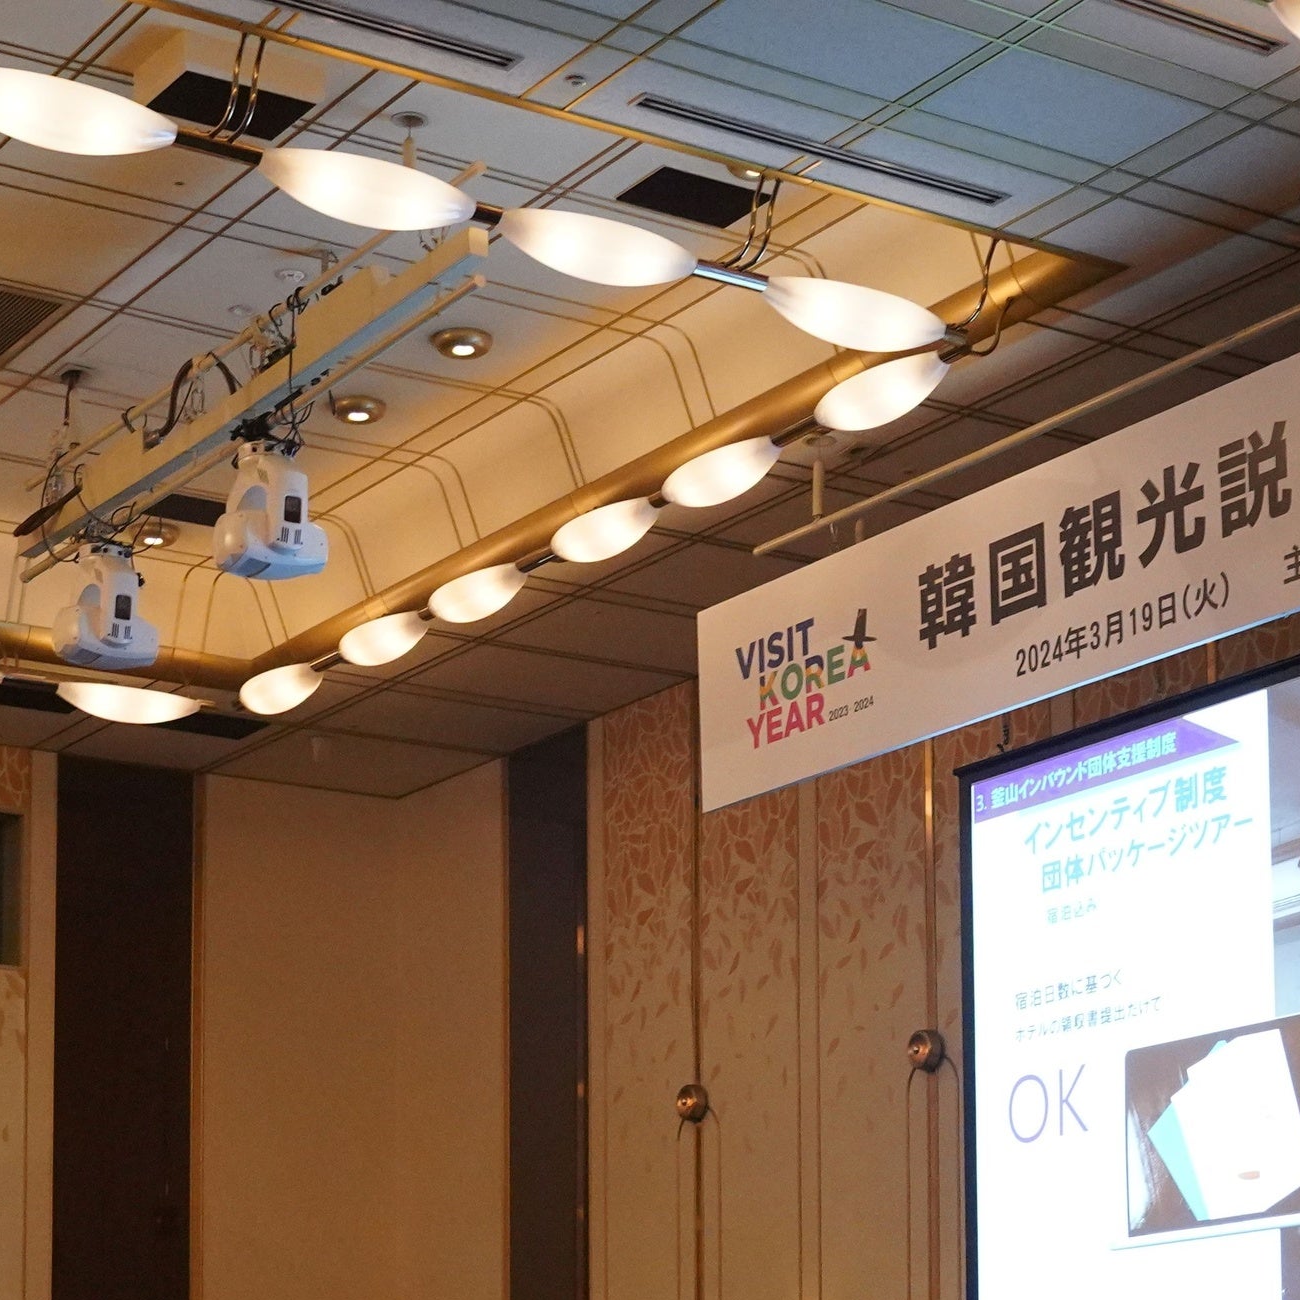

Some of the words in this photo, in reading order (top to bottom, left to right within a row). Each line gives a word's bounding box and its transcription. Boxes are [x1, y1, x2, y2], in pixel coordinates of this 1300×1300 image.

[736, 616, 815, 681] VISIT
[758, 642, 872, 711] KOREA
[746, 692, 826, 750] YEAR
[829, 704, 851, 722] 2023
[853, 695, 875, 714] 2024
[1008, 1063, 1089, 1144] OK
